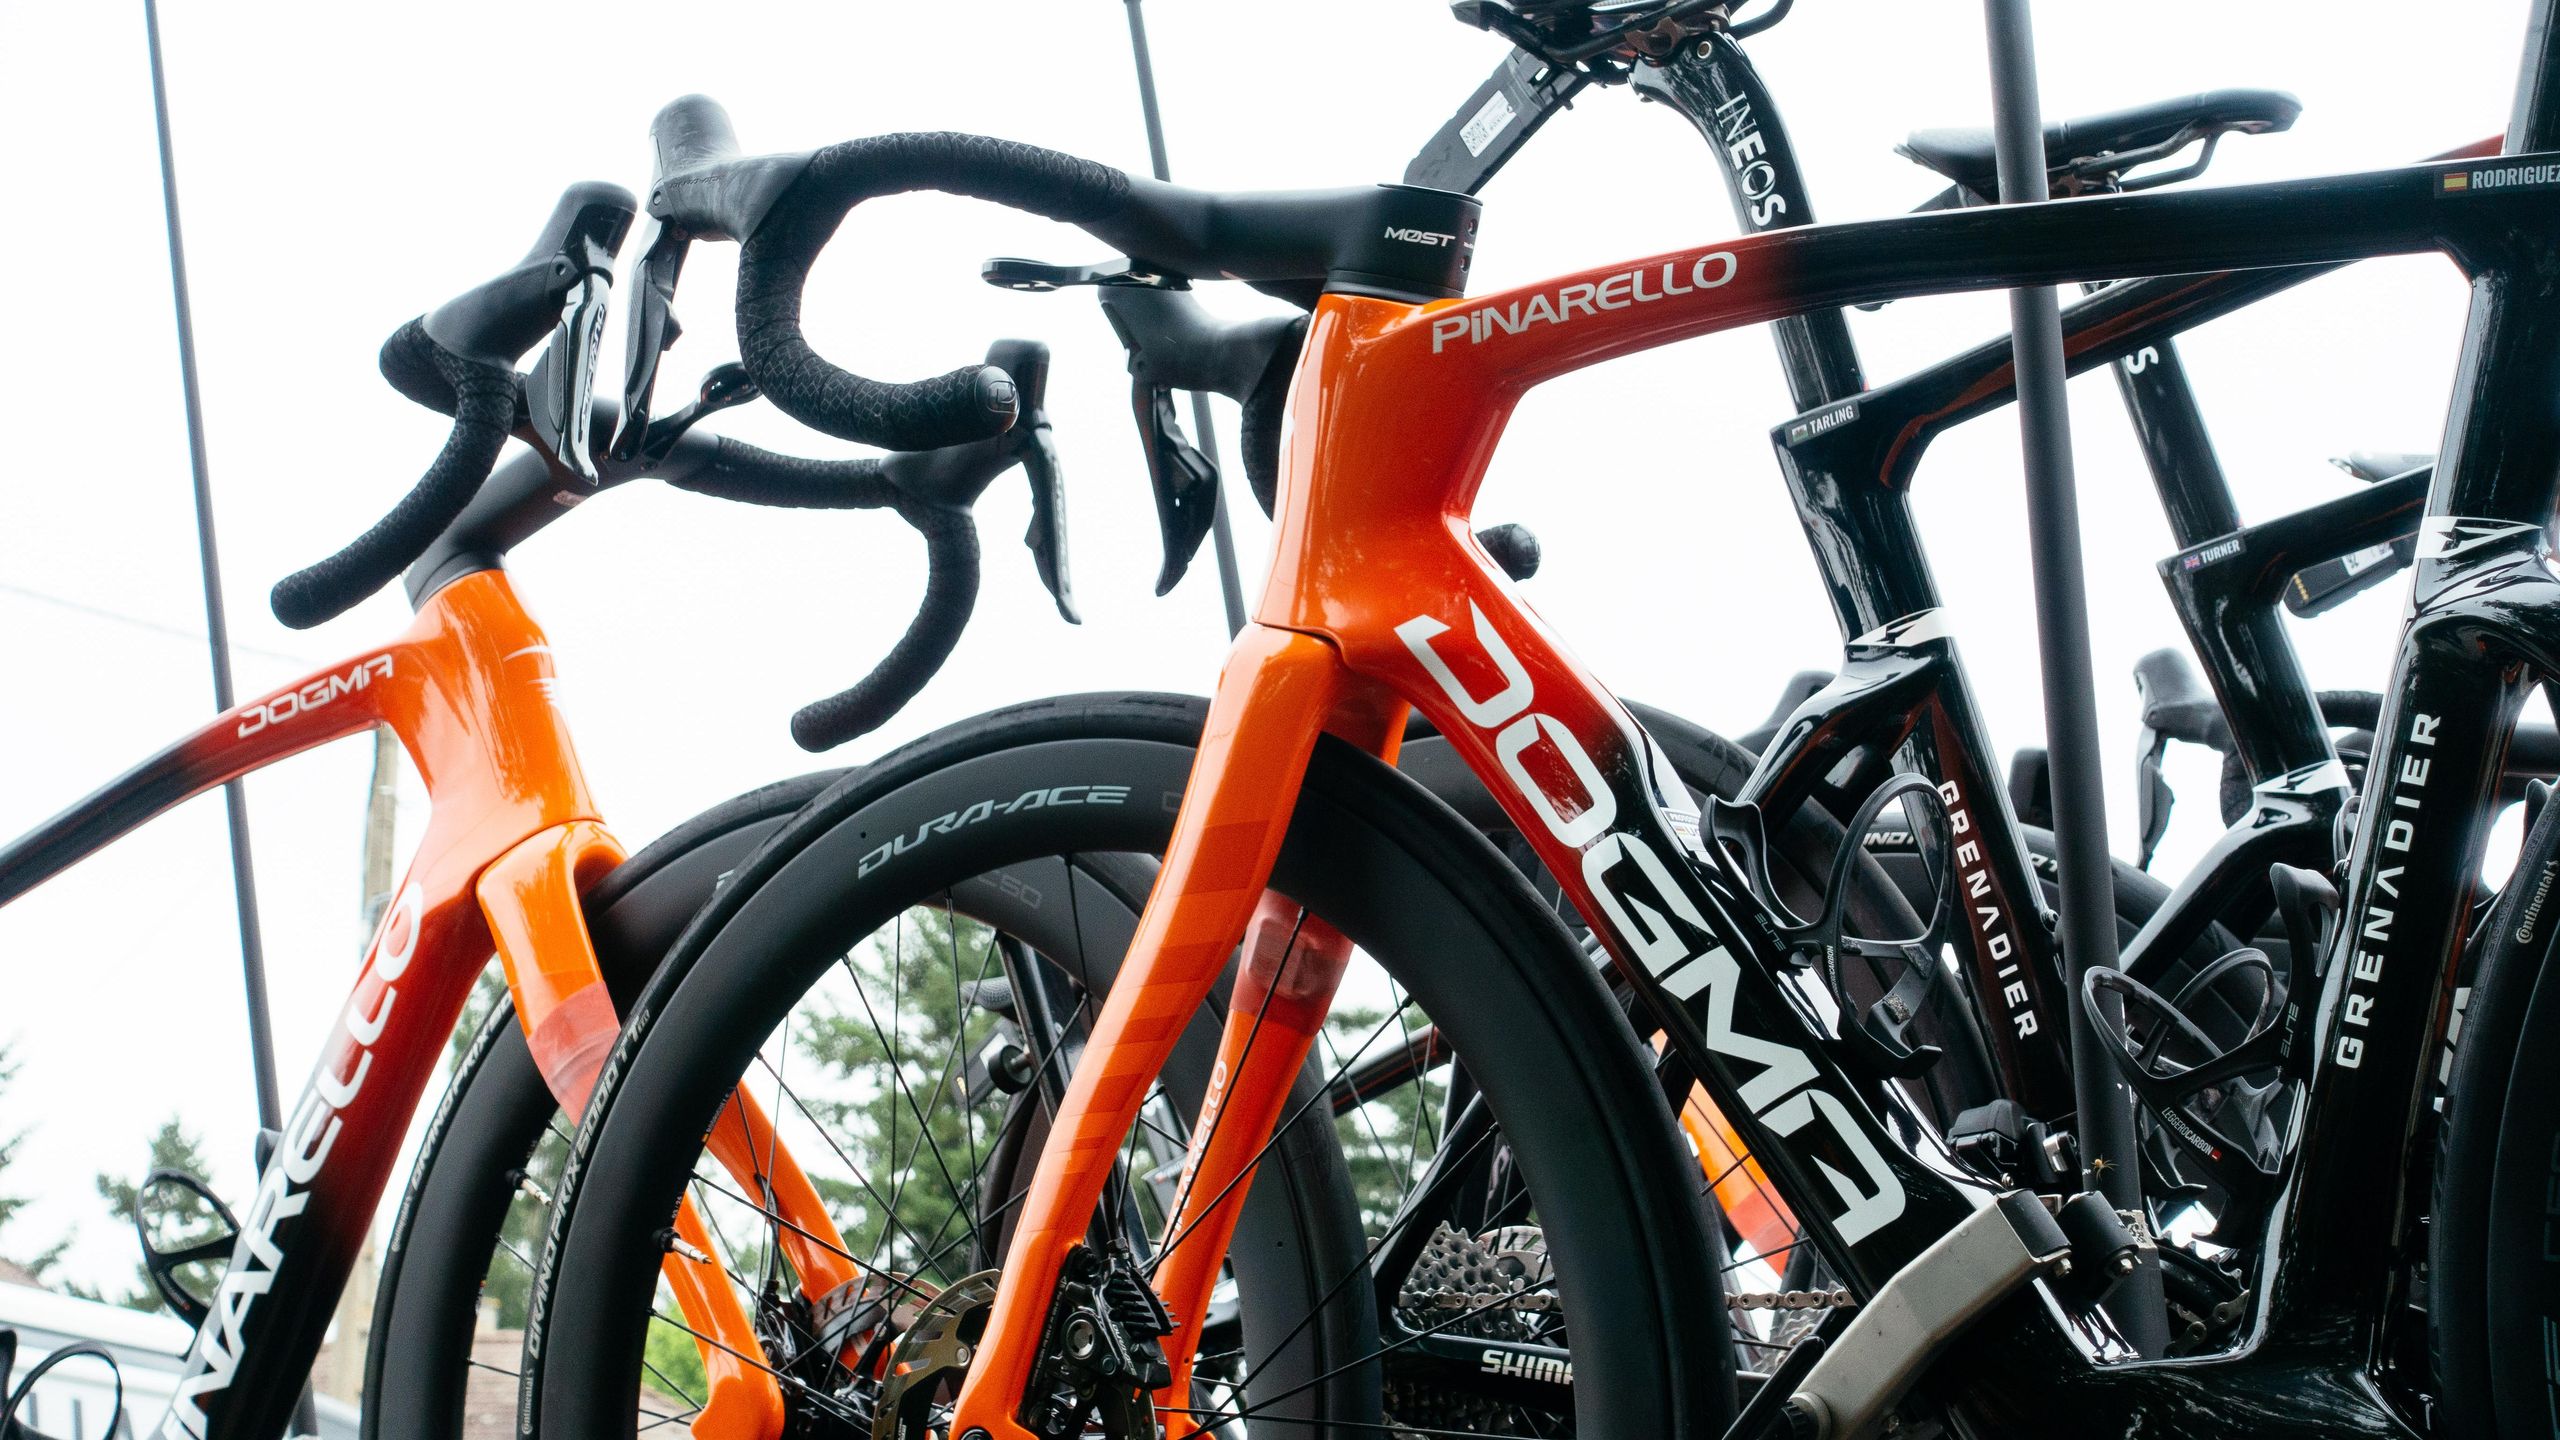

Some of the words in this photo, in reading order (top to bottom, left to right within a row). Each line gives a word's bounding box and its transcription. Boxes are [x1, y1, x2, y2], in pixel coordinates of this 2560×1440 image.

[1715, 90, 1786, 227] INEOS
[1809, 405, 1854, 434] TARLING
[2200, 540, 2240, 564] TURNER
[237, 653, 394, 740] DOGMA
[857, 785, 1132, 880] DURA-ACE
[1394, 600, 1906, 1247] DOGMA
[1754, 913, 1787, 951] ELITE
[1937, 780, 2038, 1040] GRENADIER
[2336, 713, 2441, 1069] GRENADIER
[2516, 868, 2557, 945] Continental
[2280, 1002, 2300, 1058] ELITE
[551, 1151, 581, 1242] PRIX
[1481, 1349, 1573, 1385] SHIM
